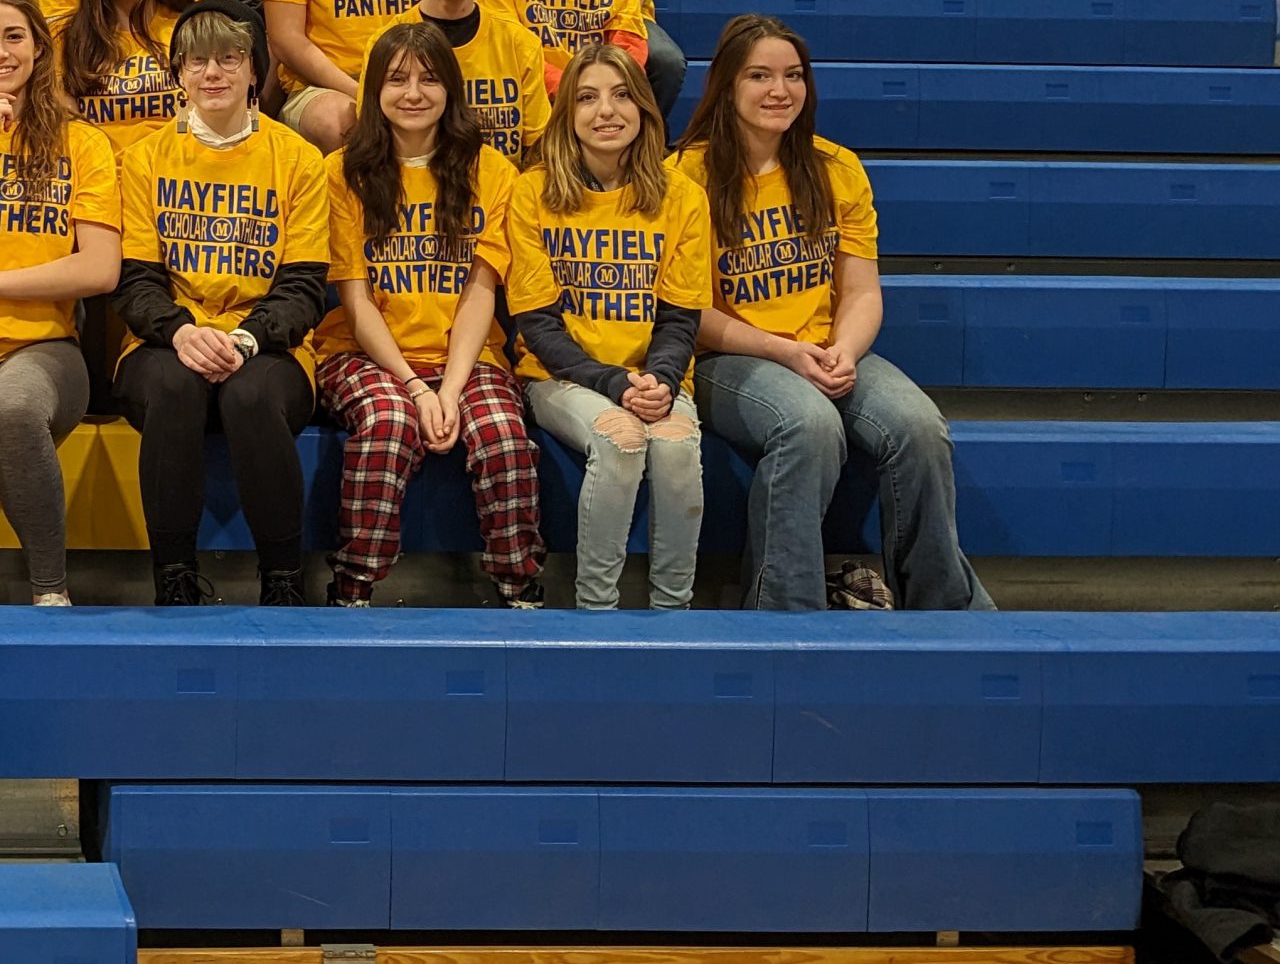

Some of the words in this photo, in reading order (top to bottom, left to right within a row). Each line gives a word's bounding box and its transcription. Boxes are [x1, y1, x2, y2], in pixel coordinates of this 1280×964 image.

[466, 78, 519, 105] IELD
[480, 107, 515, 128] THLETE
[6, 184, 18, 196] M
[157, 177, 279, 218] MAYFIELD
[163, 212, 208, 241] SCHOLAR
[216, 223, 228, 236] M
[233, 217, 271, 246] ATHLETE
[160, 241, 276, 279] PANTHERS
[372, 237, 417, 262] SCHOLAR
[425, 241, 435, 254] M
[727, 243, 773, 275] SCHOLAR
[779, 244, 792, 259] M
[367, 264, 469, 294] PANTHER
[600, 268, 614, 283] M
[720, 258, 831, 304] PANTHER
[560, 289, 656, 322] ANTHER
